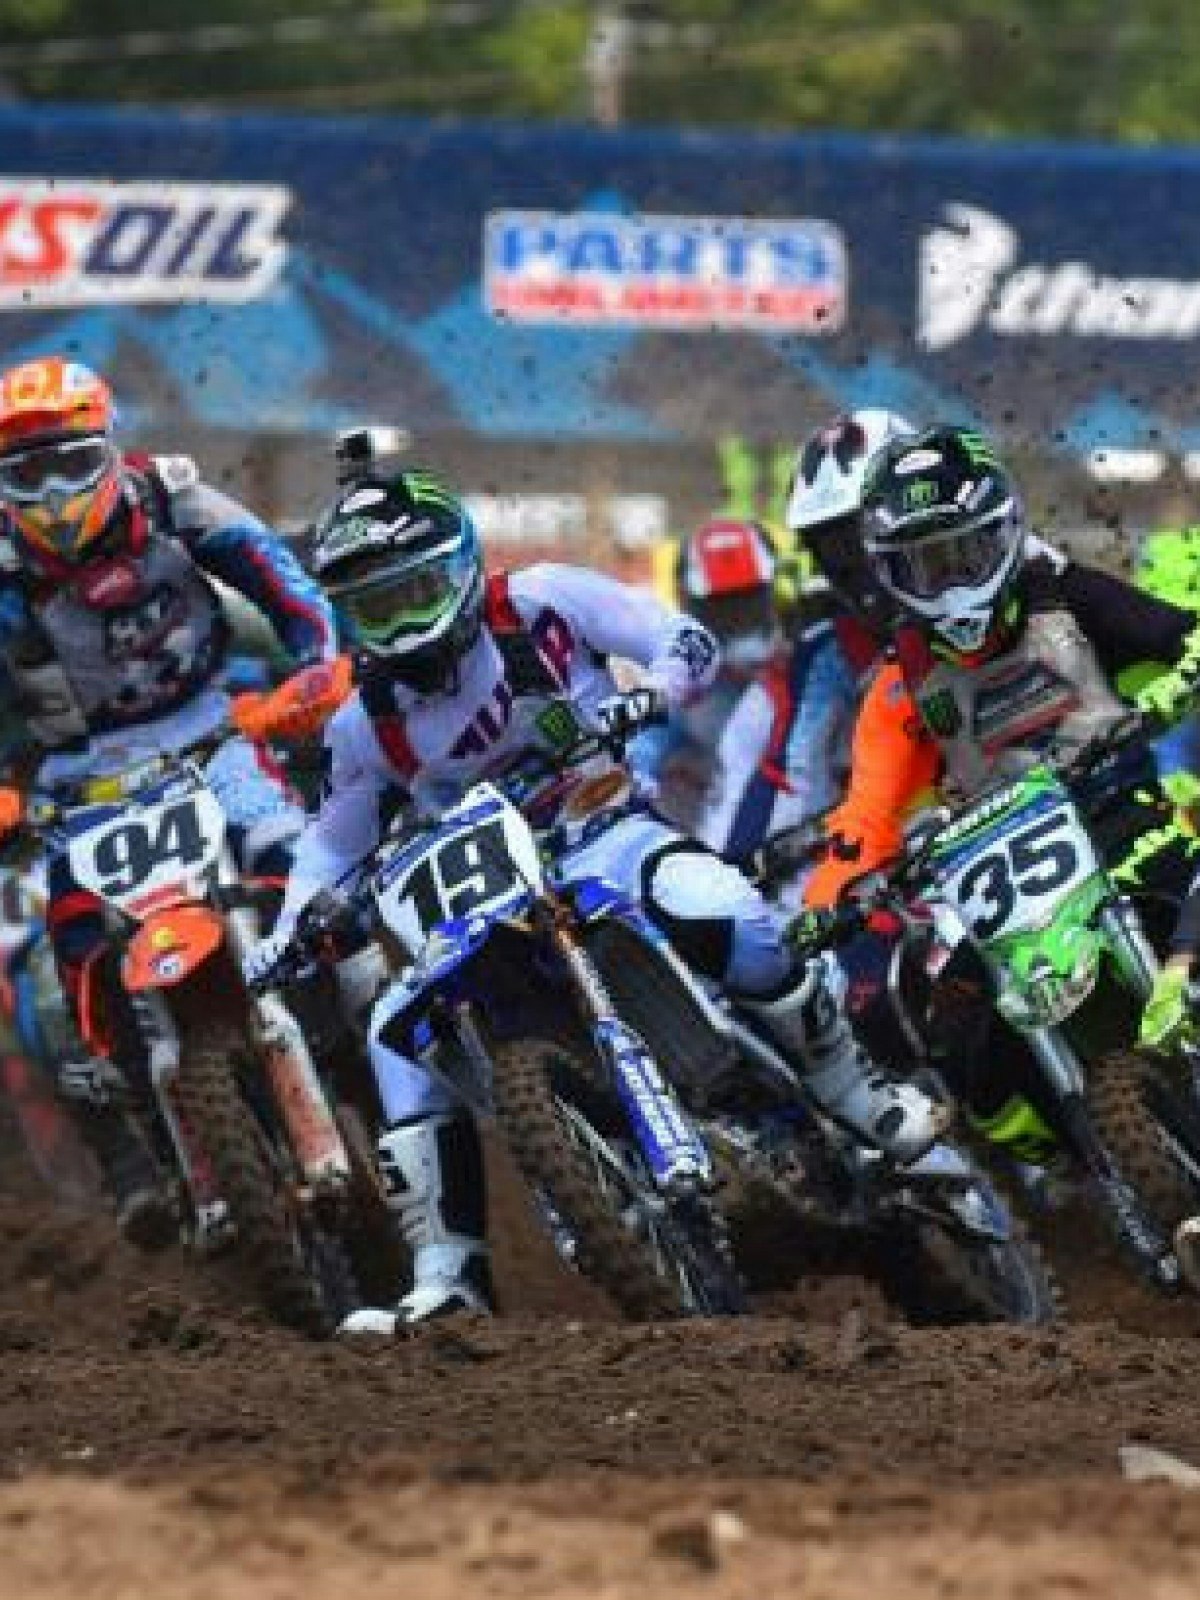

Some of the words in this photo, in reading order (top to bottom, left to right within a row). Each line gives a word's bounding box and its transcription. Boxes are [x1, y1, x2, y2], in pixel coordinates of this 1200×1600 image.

[0, 198, 261, 282] SOIL
[498, 226, 830, 281] PARTS
[94, 801, 211, 896] 94
[399, 817, 527, 933] 19
[957, 811, 1079, 941] 35
